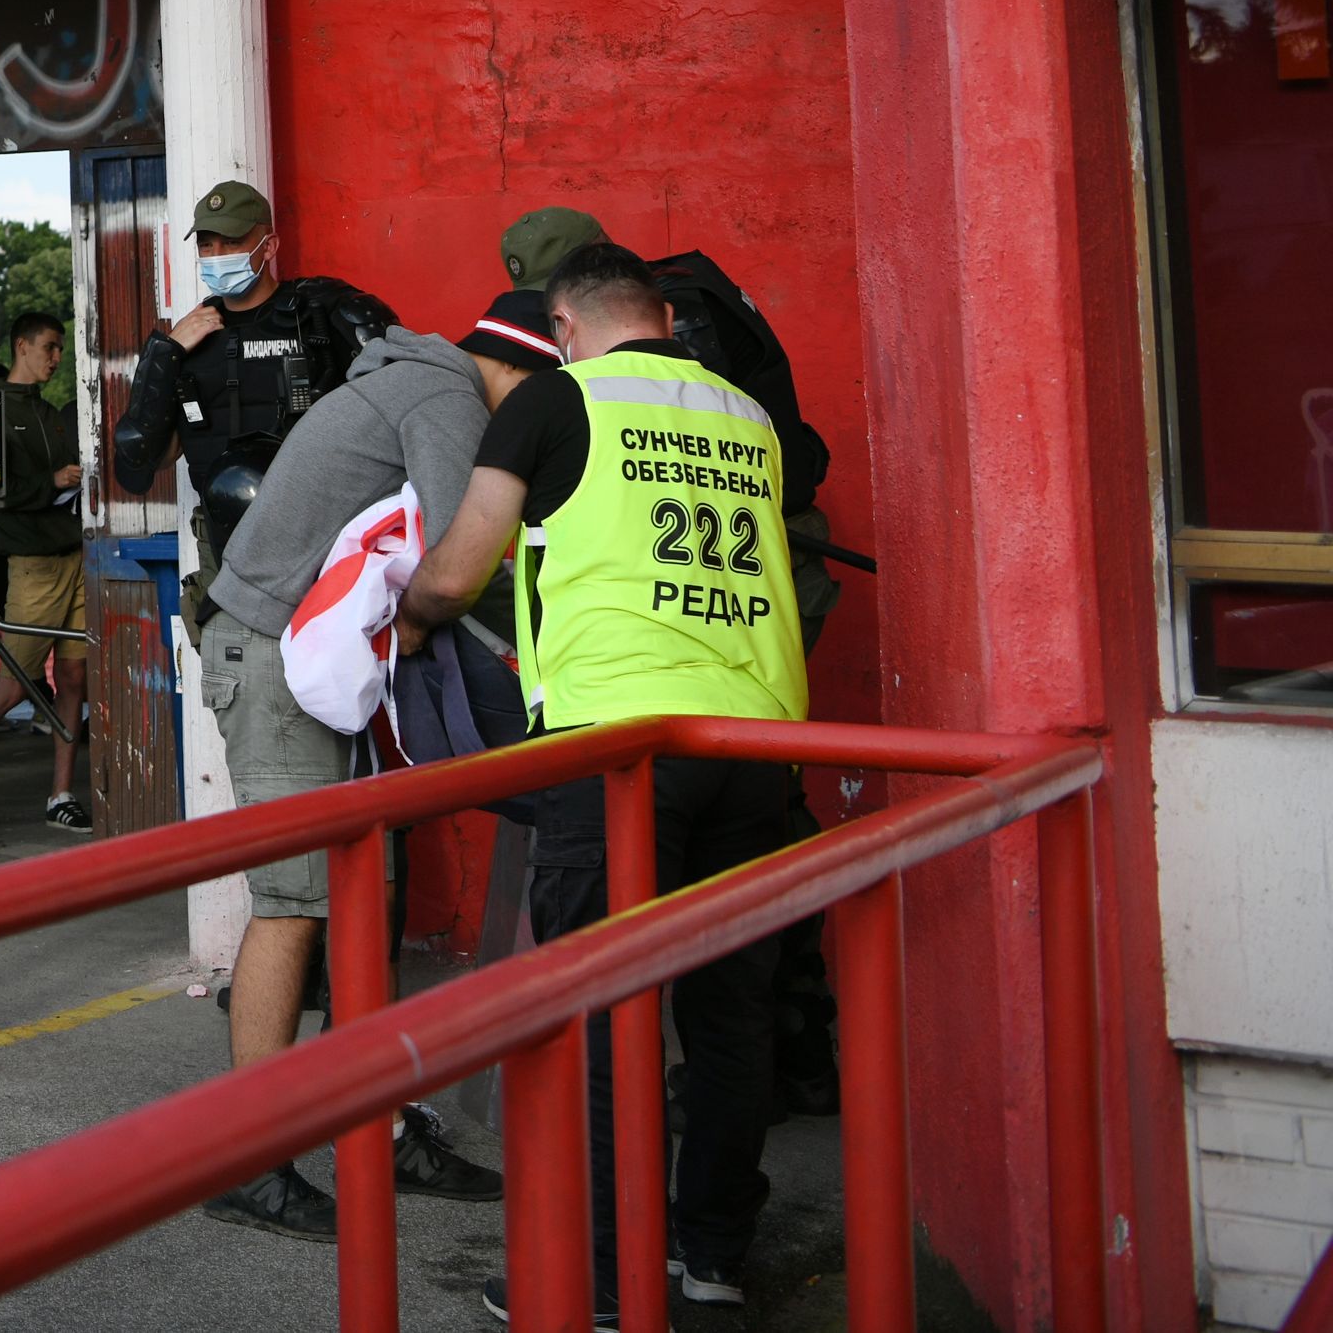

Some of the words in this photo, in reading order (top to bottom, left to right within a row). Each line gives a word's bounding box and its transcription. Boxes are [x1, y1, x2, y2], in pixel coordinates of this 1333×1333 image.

[621, 428, 712, 458] СУНЧЕВ
[718, 439, 766, 468] КРУГ
[622, 459, 772, 500] ОБЕЗБЕЂЕЊА
[651, 498, 762, 577] 222
[652, 581, 771, 627] РЕДАР
